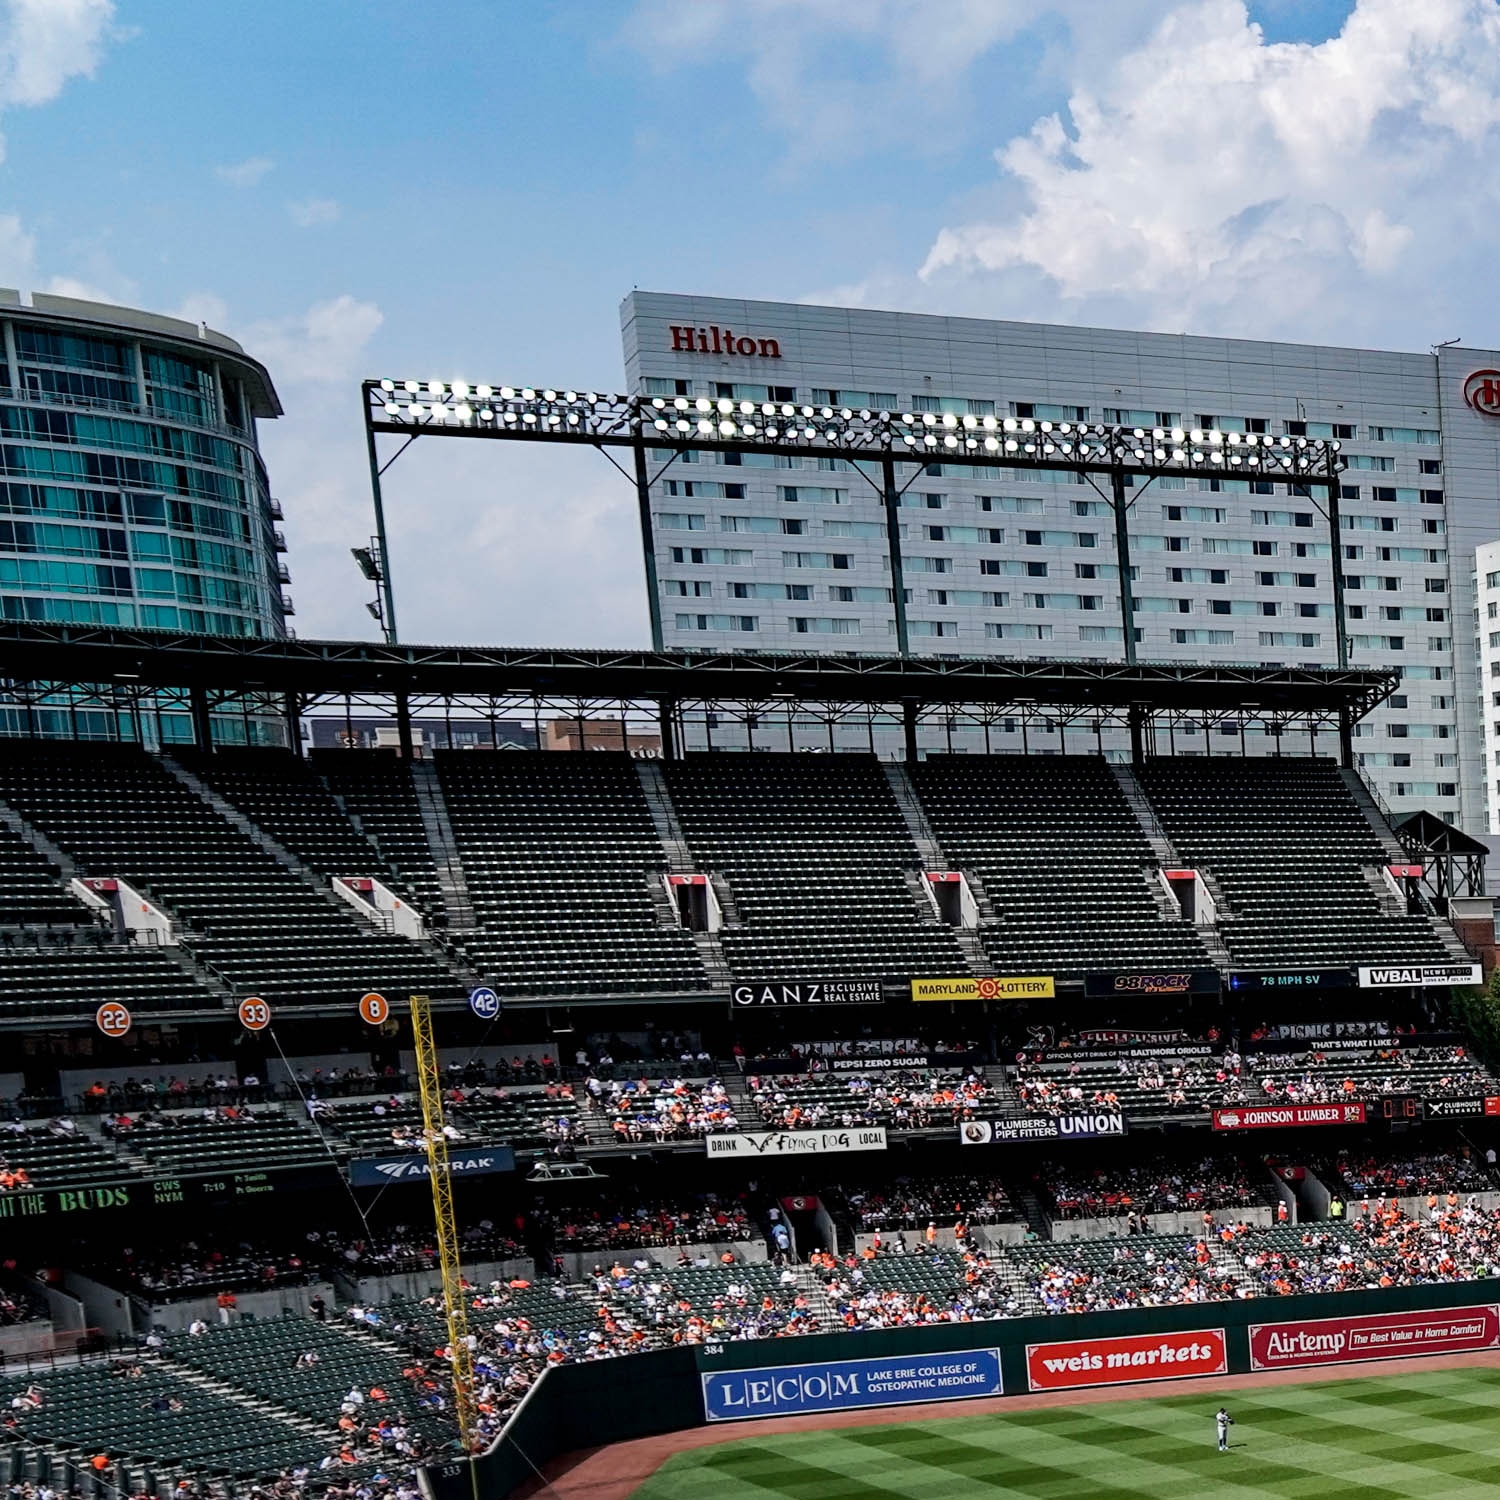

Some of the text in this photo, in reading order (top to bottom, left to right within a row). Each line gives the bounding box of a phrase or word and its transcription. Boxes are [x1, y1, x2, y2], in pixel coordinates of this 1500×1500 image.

[670, 326, 782, 358] Hilton
[1261, 975, 1320, 985] 78 MPH SV
[1372, 970, 1421, 984] WBAL
[735, 982, 880, 1005] GANZ EXCLUSIVE
[824, 992, 881, 1002] REAL ESTATE
[918, 982, 1047, 995] MARYLAND LOTTERY
[368, 999, 380, 1018] 8
[475, 993, 497, 1012] 42
[102, 1011, 126, 1029] 22
[245, 1004, 266, 1023] 33
[1130, 1048, 1176, 1057] BALTIMORE
[1176, 1046, 1212, 1055] ORIOLES
[1311, 1041, 1341, 1049] THAT'S
[1342, 1040, 1367, 1048] WHAT
[833, 1058, 928, 1069] PEPSI ZERO SUGAR
[1444, 1100, 1482, 1109] CLUBHOUSE
[995, 1119, 1047, 1130] PLUMBERS
[1060, 1114, 1123, 1134] UNION
[1243, 1108, 1339, 1125] JOHNSON LUMBER
[995, 1127, 1058, 1139] PIPE FITTERS
[711, 1140, 737, 1151] DRINK
[859, 1133, 883, 1144] LOCAL
[153, 1180, 181, 1191] CWS
[21, 1186, 130, 1215] THE BUDS
[154, 1191, 184, 1203] NYM
[1353, 1323, 1482, 1344] The Best Value Home Comfort
[703, 1344, 724, 1355] 384
[1267, 1331, 1345, 1356] Airtemp
[1042, 1343, 1212, 1373] weis markets
[867, 1363, 977, 1381] LAKE ERIE COLLEGE OF
[868, 1373, 985, 1393] OSTEOPATHIC MEDICINE
